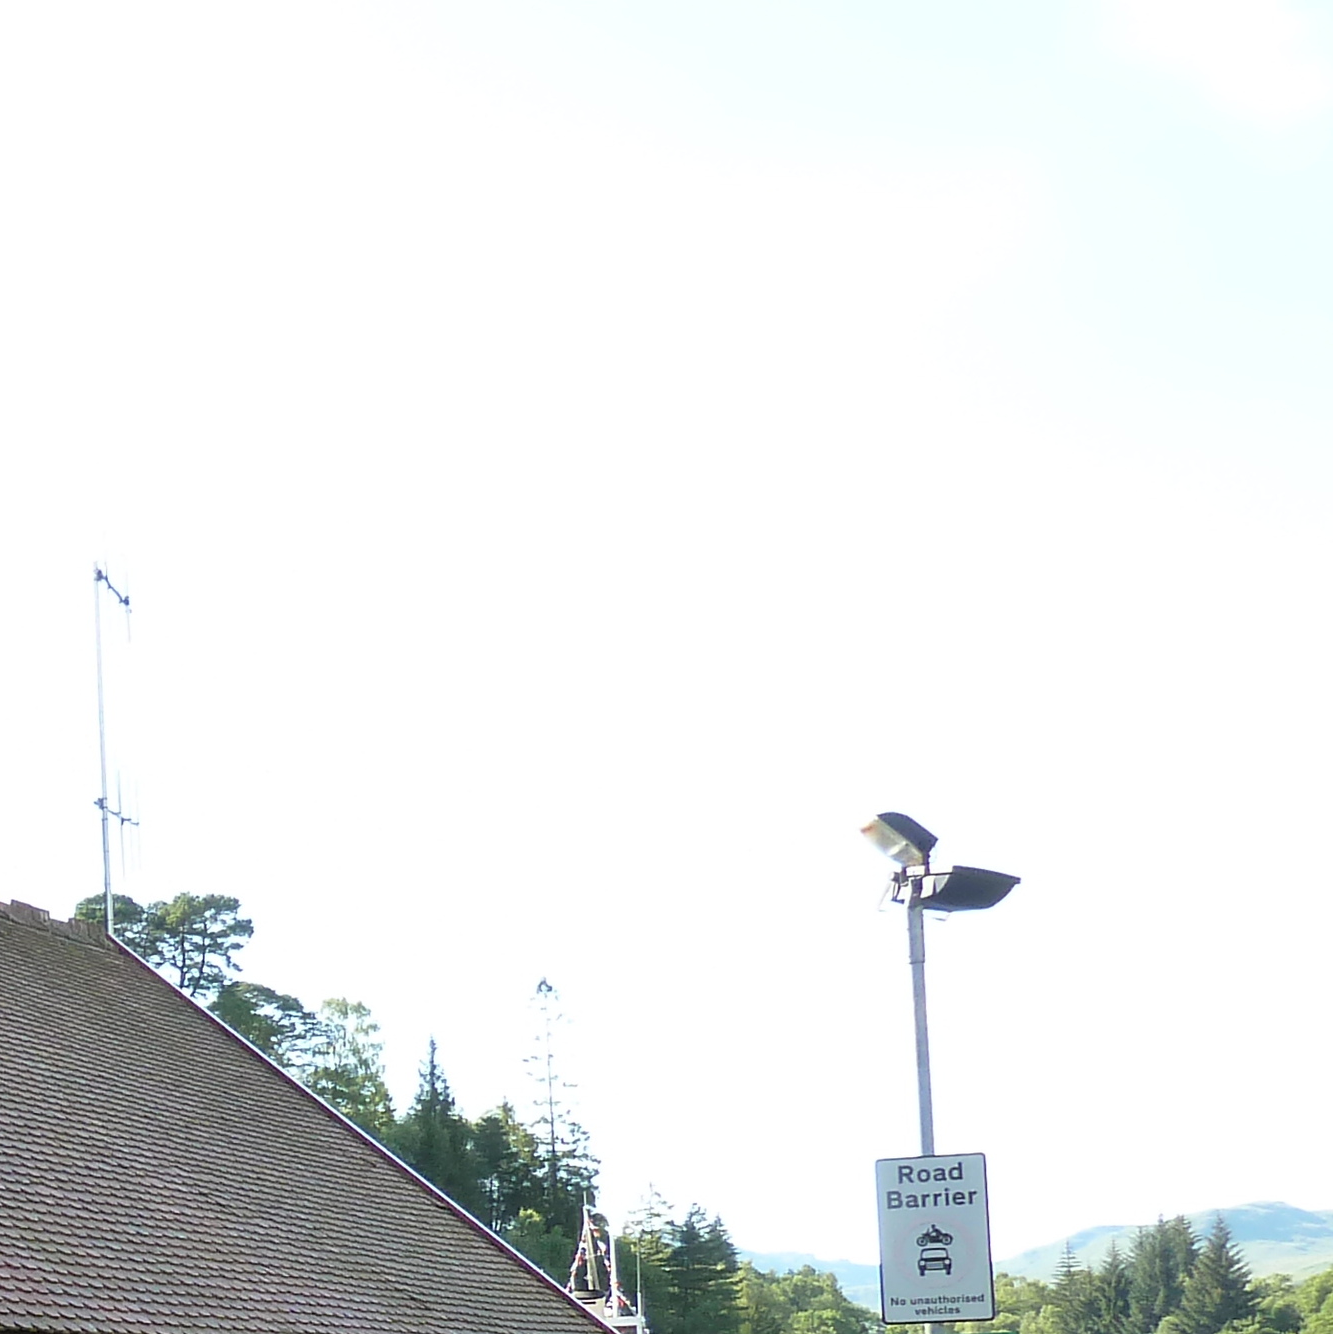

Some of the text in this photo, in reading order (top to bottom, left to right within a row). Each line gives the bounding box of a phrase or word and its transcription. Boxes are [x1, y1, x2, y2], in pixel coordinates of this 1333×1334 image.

[897, 1162, 964, 1184] Road
[886, 1188, 979, 1209] Barrier
[890, 1293, 985, 1307] No unauthorised
[914, 1305, 961, 1316] vehicles
